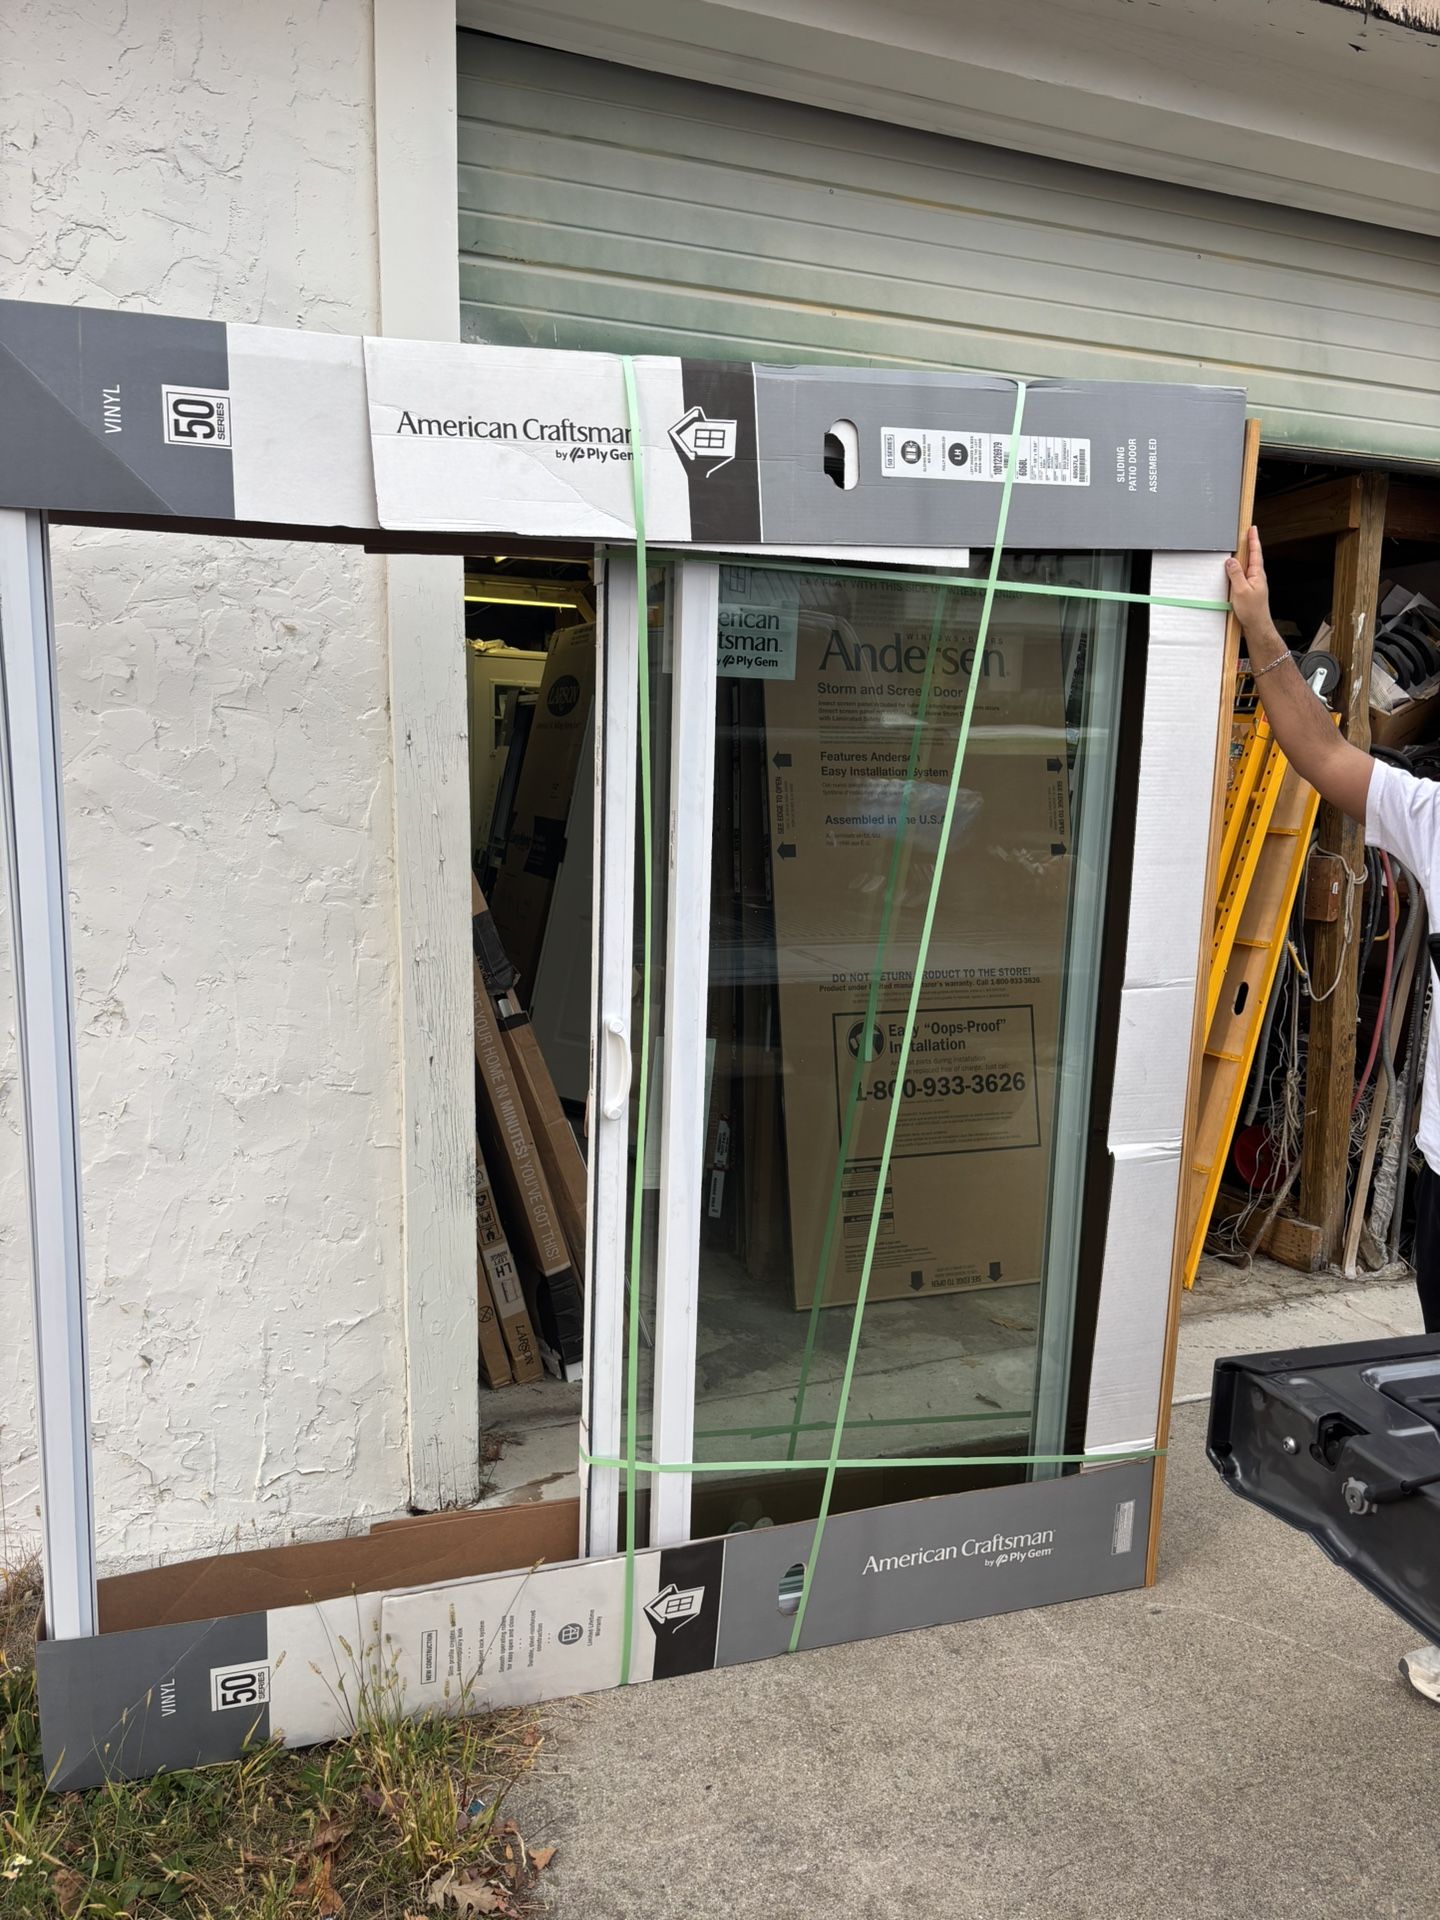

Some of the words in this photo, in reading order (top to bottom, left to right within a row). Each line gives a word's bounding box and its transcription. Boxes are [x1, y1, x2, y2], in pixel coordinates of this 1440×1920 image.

[102, 384, 122, 434] VINYL
[172, 398, 216, 440] 50
[216, 402, 226, 440] SERIES
[397, 411, 518, 439] American
[555, 449, 568, 461] by
[587, 448, 608, 464] Ply
[954, 449, 962, 460] LH
[1128, 438, 1137, 464] DOOR
[1116, 446, 1125, 482] SLIDING
[1148, 438, 1158, 492] ASSEMBLED
[1128, 466, 1137, 492] PATIO
[852, 581, 878, 591] WITH
[882, 582, 903, 592] THIS
[905, 584, 929, 593] SIDE
[718, 608, 780, 630] erican
[906, 633, 959, 642] WINOWS
[736, 656, 754, 669] Ply
[754, 656, 778, 668] Gem
[817, 682, 856, 695] Storm
[860, 684, 884, 696] and
[887, 684, 930, 697] Scree
[934, 686, 964, 698] Door
[820, 752, 868, 762] Features
[821, 767, 846, 778] Easy
[850, 766, 908, 777] Installation
[914, 768, 948, 778] System
[825, 815, 884, 824] Assembled
[888, 815, 897, 824] in
[819, 984, 846, 992] Product
[976, 978, 989, 986] Call
[832, 974, 847, 983] DO
[850, 972, 870, 982] NOT
[877, 972, 912, 982] ETURN
[919, 970, 961, 980] RODUCT
[964, 969, 975, 978] TO
[978, 968, 995, 978] THE
[998, 967, 1031, 976] STORE!
[475, 1009, 493, 1048] YOUR
[888, 1024, 920, 1037] Eay
[889, 1038, 966, 1054] Intallation
[483, 1046, 506, 1084] HOME
[496, 1084, 510, 1099] IN
[500, 1098, 529, 1160] MINUTES!
[520, 1160, 543, 1204] YOU'VE
[533, 1204, 551, 1228] GOT
[542, 1228, 560, 1262] THIS!
[495, 1262, 512, 1278] LH
[515, 1324, 534, 1366] LARSON
[862, 1547, 957, 1576] American
[961, 1530, 1054, 1557] Craftsman
[984, 1558, 995, 1568] by
[1010, 1551, 1026, 1563] Ply
[1028, 1548, 1052, 1559] Gem
[448, 1648, 456, 1664] profile
[498, 1654, 506, 1672] Smooth
[220, 1674, 256, 1706] 50
[258, 1671, 266, 1700] SERIES
[160, 1678, 176, 1718] VINYL
